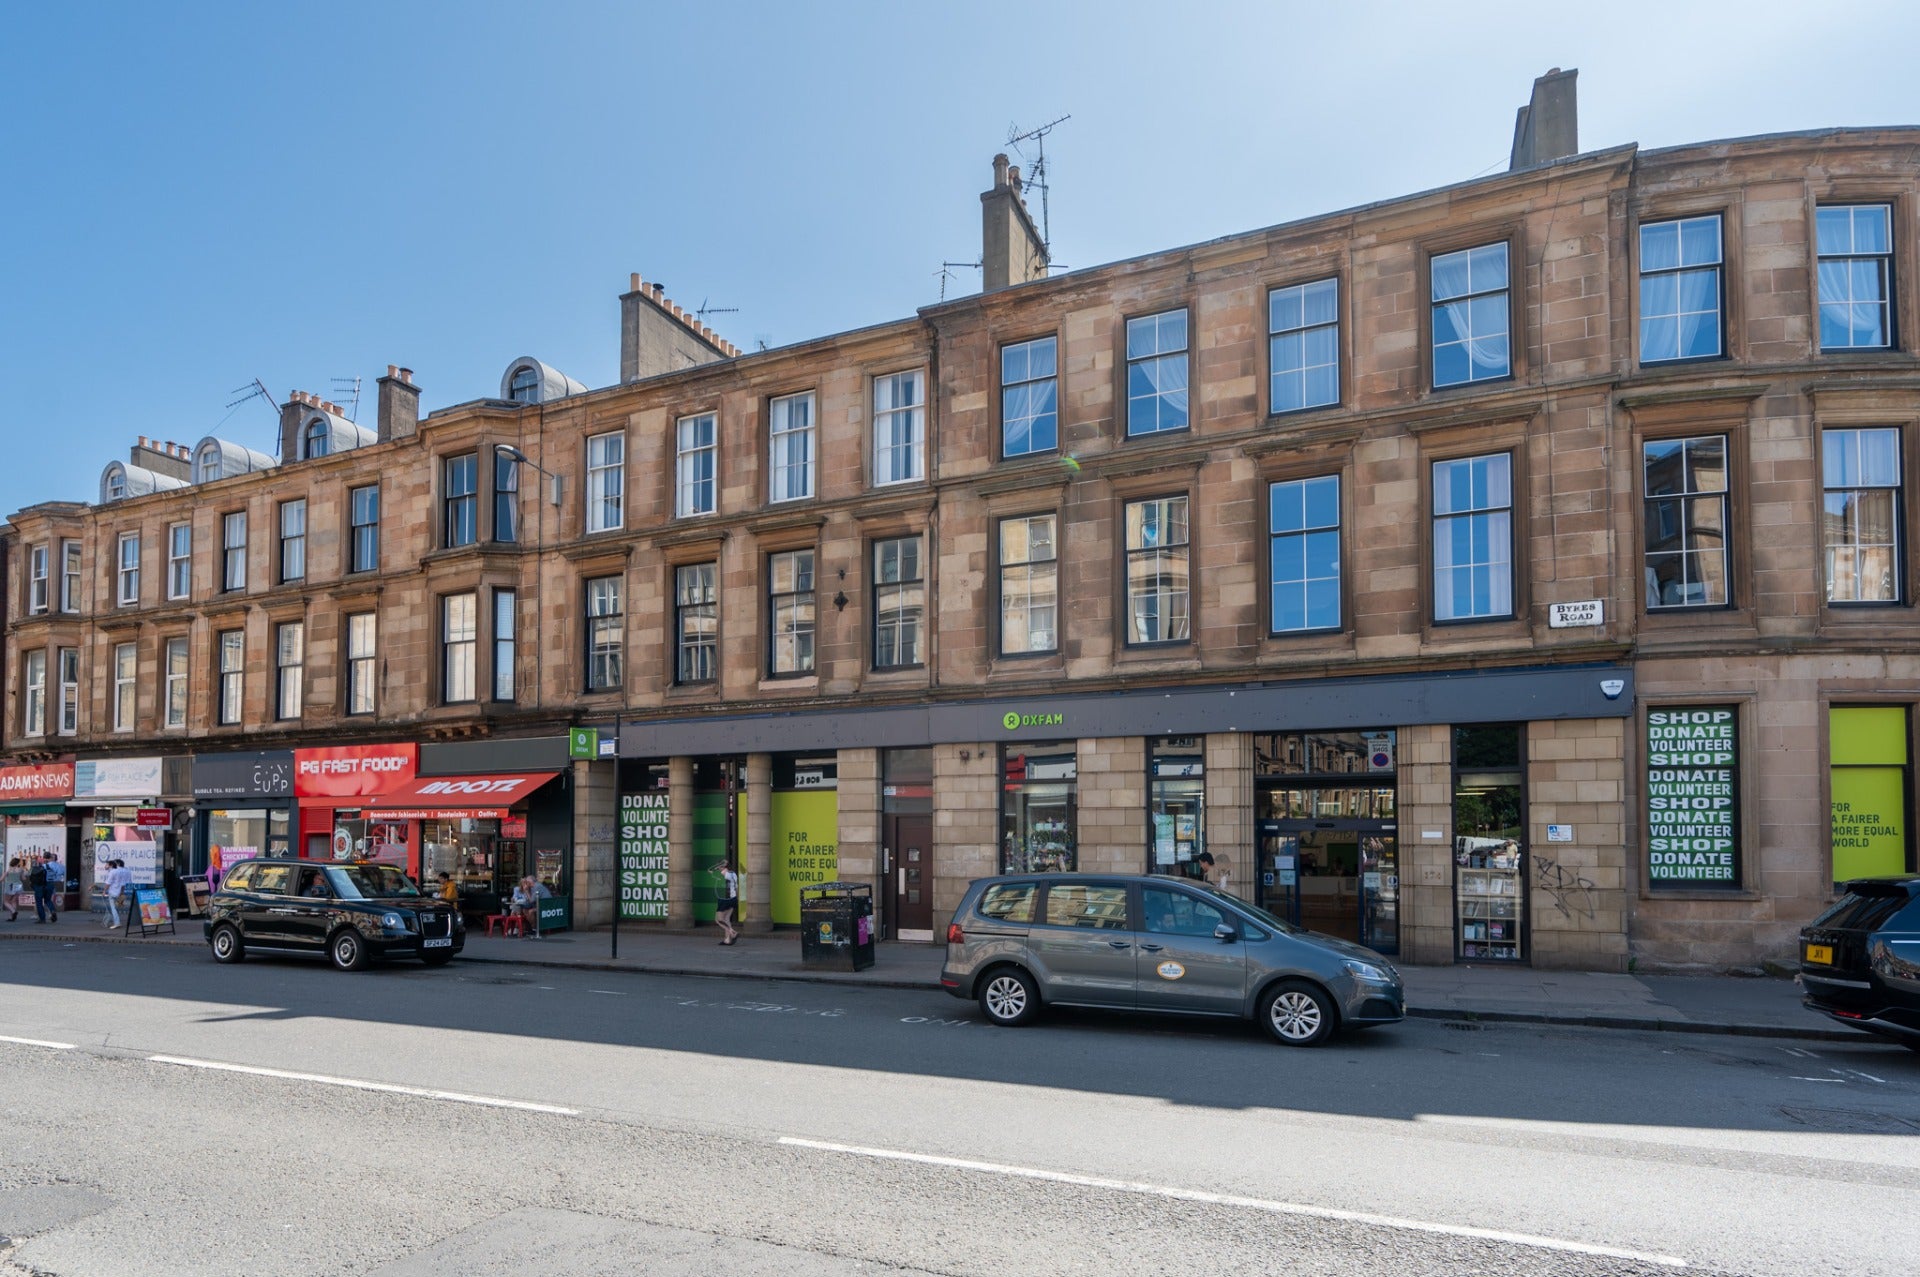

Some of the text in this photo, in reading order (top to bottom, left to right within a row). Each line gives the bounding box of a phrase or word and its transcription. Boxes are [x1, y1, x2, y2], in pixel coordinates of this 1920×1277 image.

[1557, 604, 1596, 613] BYRES
[1560, 613, 1593, 622] ROAD
[1022, 713, 1063, 726] OXFAM
[1649, 711, 1732, 725] SHOP
[1649, 725, 1732, 739] DONATE
[1649, 739, 1732, 752] VOLUNTEER
[1650, 752, 1732, 766] SHOP
[300, 760, 320, 775] PG
[321, 758, 360, 774] FAST
[361, 757, 401, 772] FOOD
[0, 774, 40, 790] ADAM'S
[40, 772, 70, 788] NEWS
[1649, 769, 1731, 782] DONATE
[415, 778, 527, 795] MOOTZ
[1649, 783, 1731, 796] VOLUNTEER
[1649, 797, 1731, 810] SHOP
[1831, 802, 1850, 812] FOR
[622, 810, 669, 824] VOLUNTE
[1649, 811, 1732, 823] DONATE
[1831, 814, 1880, 824] A FAIRER
[621, 825, 667, 839] SHO
[788, 832, 808, 842] FOR
[1650, 824, 1732, 837] VOLUNTEER
[1831, 826, 1899, 837] MORE EQUAL
[1650, 838, 1732, 851] SHOP
[1832, 838, 1869, 848] WORLD
[112, 848, 156, 860] FISH PLAICE
[788, 845, 834, 855] A FAIRER
[622, 856, 669, 870] VOLUNTE
[788, 858, 816, 869] MORE
[1650, 852, 1732, 865] DONATE
[622, 871, 668, 885] SHO
[788, 871, 824, 882] WORLD
[1651, 865, 1733, 879] VOLUNTEER
[622, 902, 669, 917] VOLUNTE
